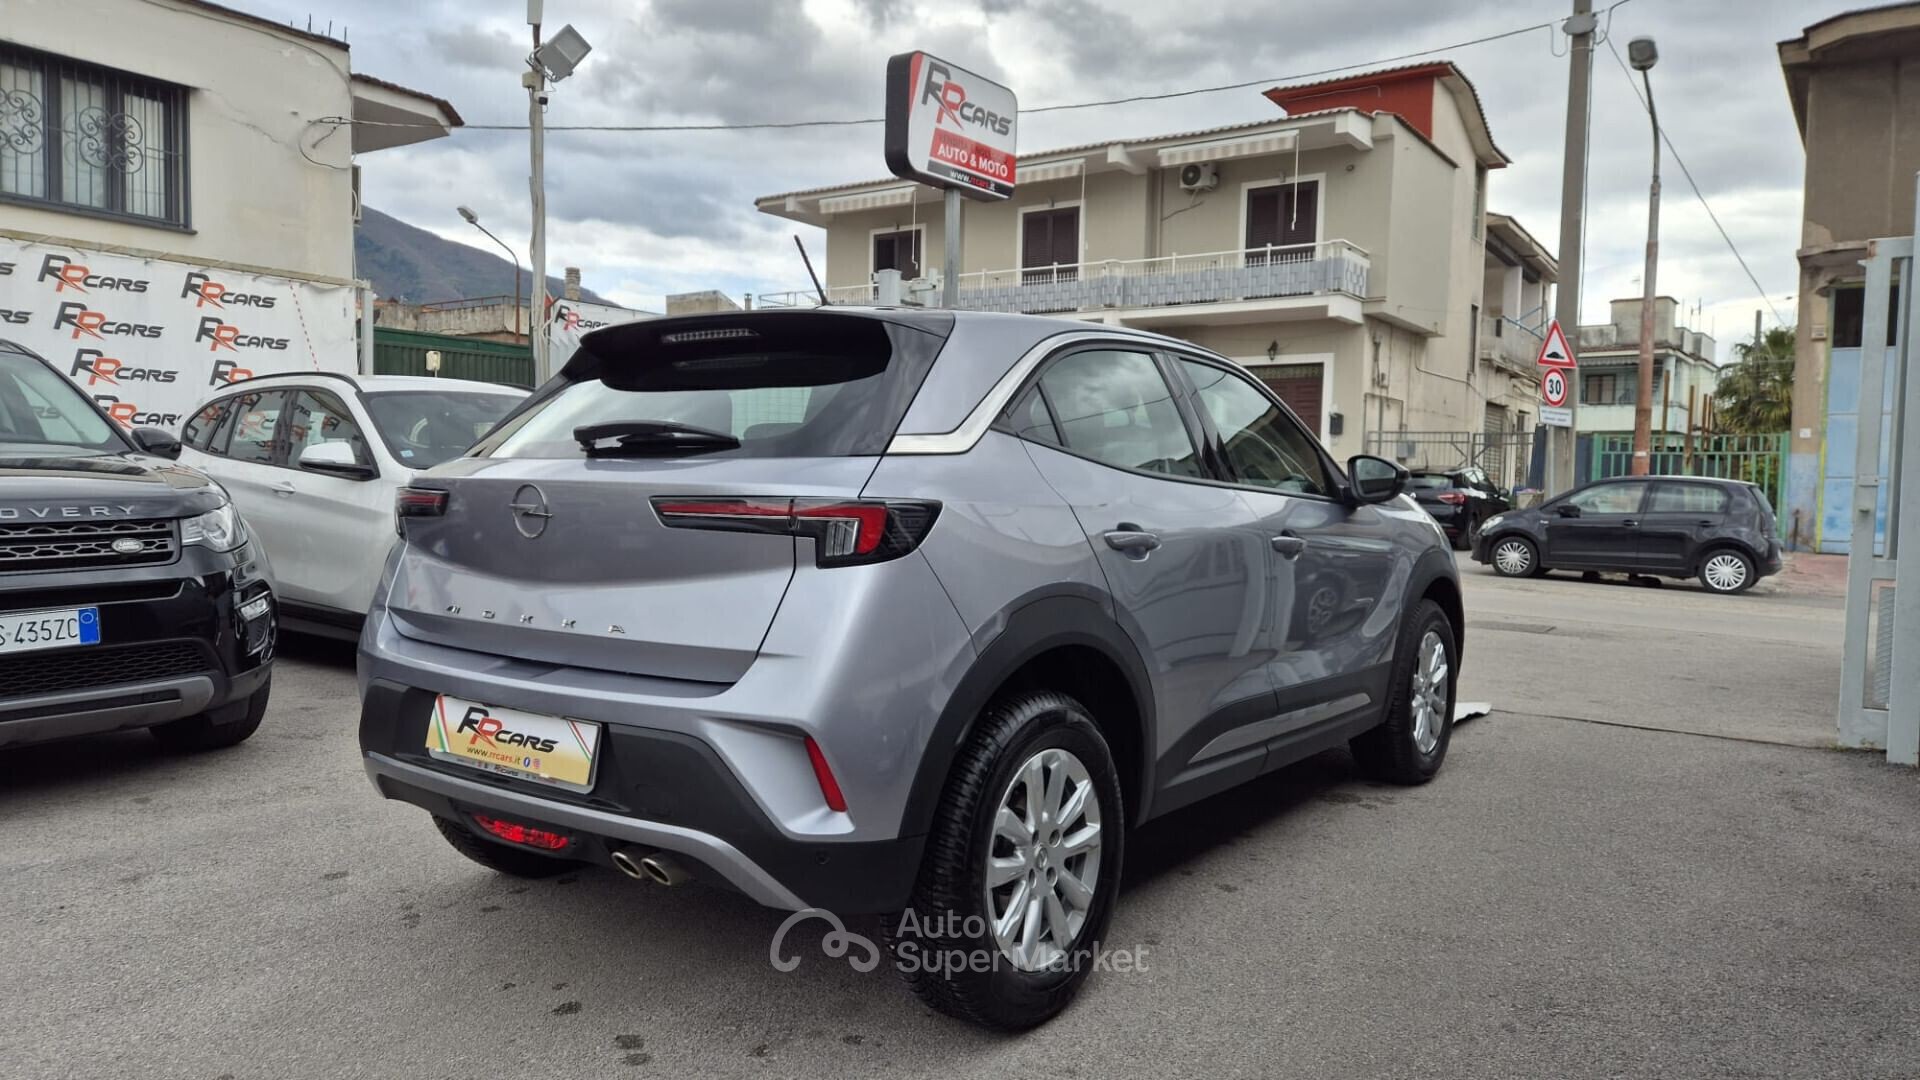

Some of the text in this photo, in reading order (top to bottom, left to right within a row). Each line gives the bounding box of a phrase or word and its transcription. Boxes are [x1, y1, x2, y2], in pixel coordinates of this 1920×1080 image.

[938, 144, 1008, 177] AUTO & MOTO
[1548, 378, 1561, 395] 30
[467, 747, 521, 765] www.rrcars.it
